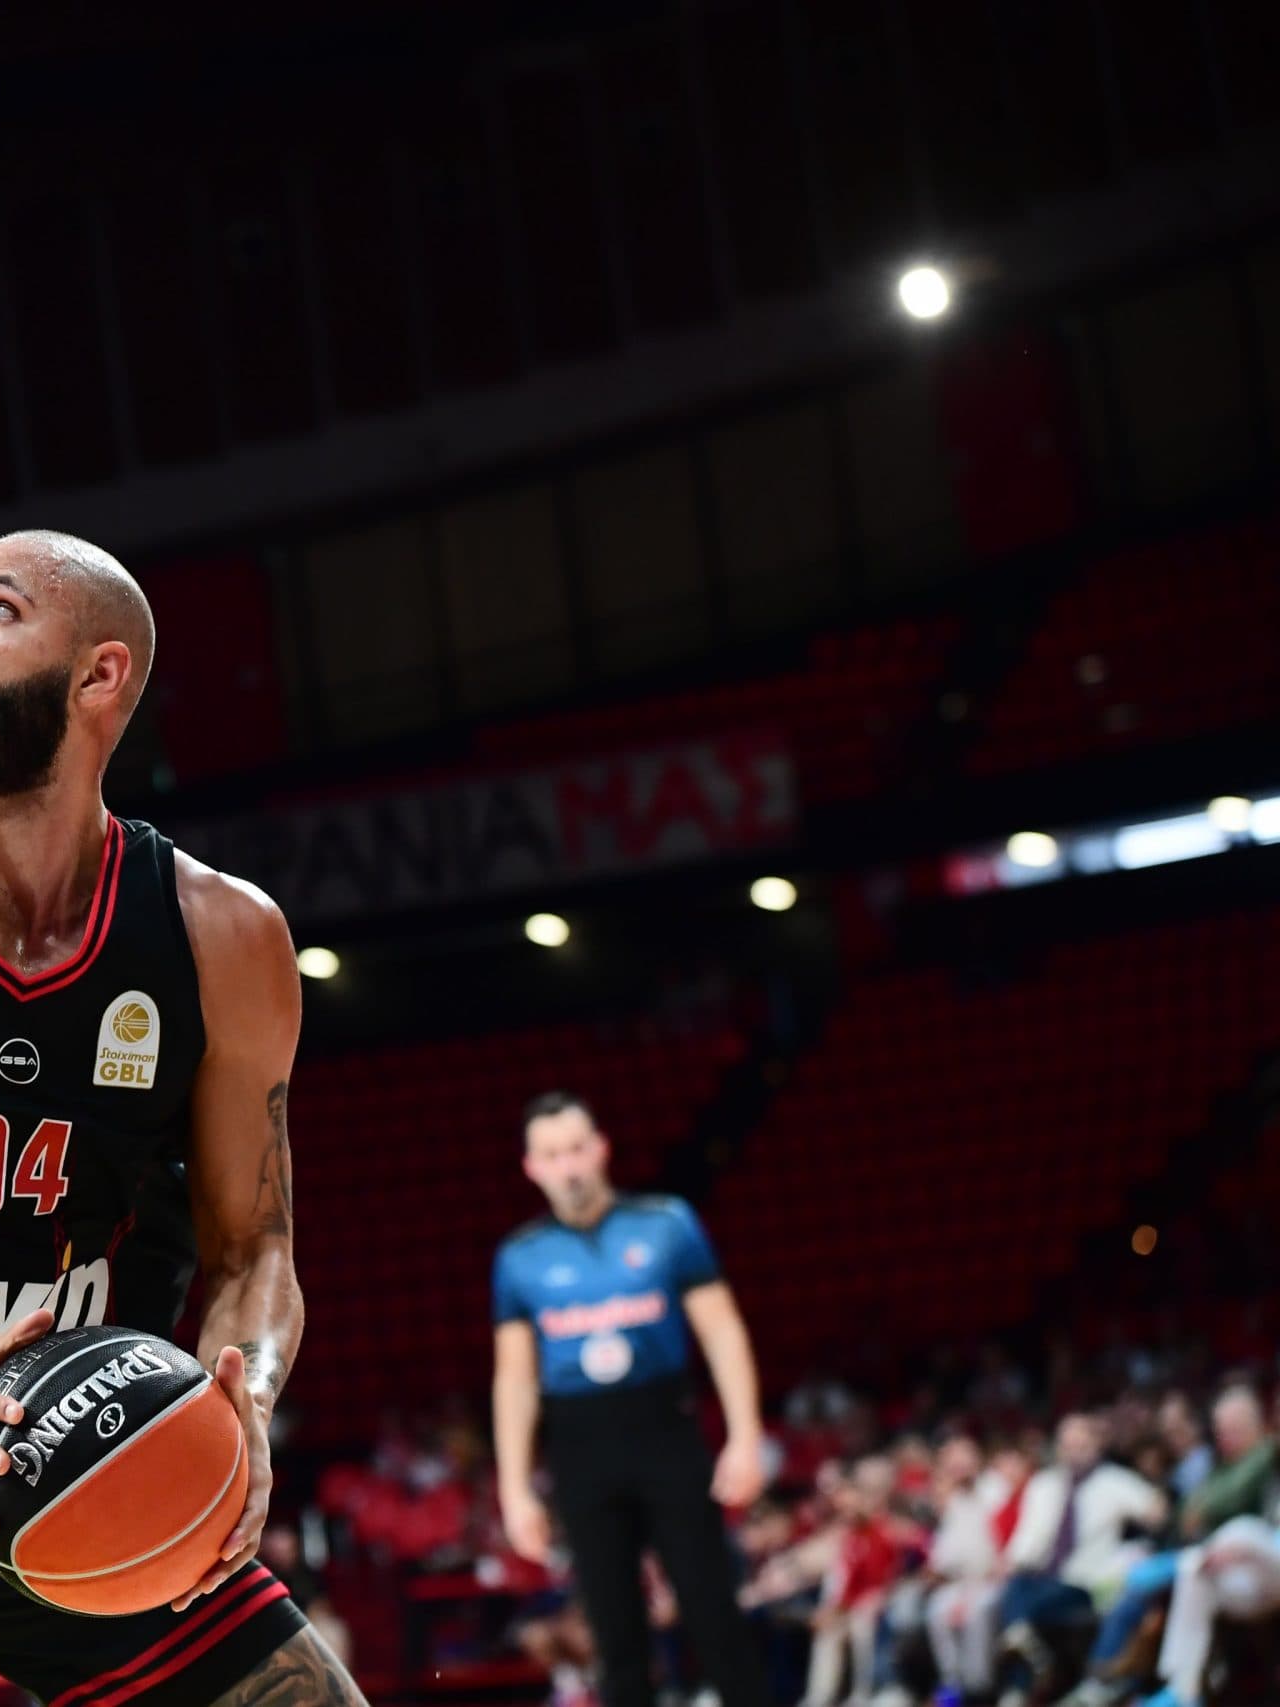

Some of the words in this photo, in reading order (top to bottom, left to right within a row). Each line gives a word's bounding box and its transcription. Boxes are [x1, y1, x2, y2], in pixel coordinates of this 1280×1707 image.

[0, 1055, 37, 1066] GSA
[99, 1047, 156, 1063] Stoiximan
[99, 1061, 149, 1084] GBL
[8, 1343, 173, 1488] SPALDING
